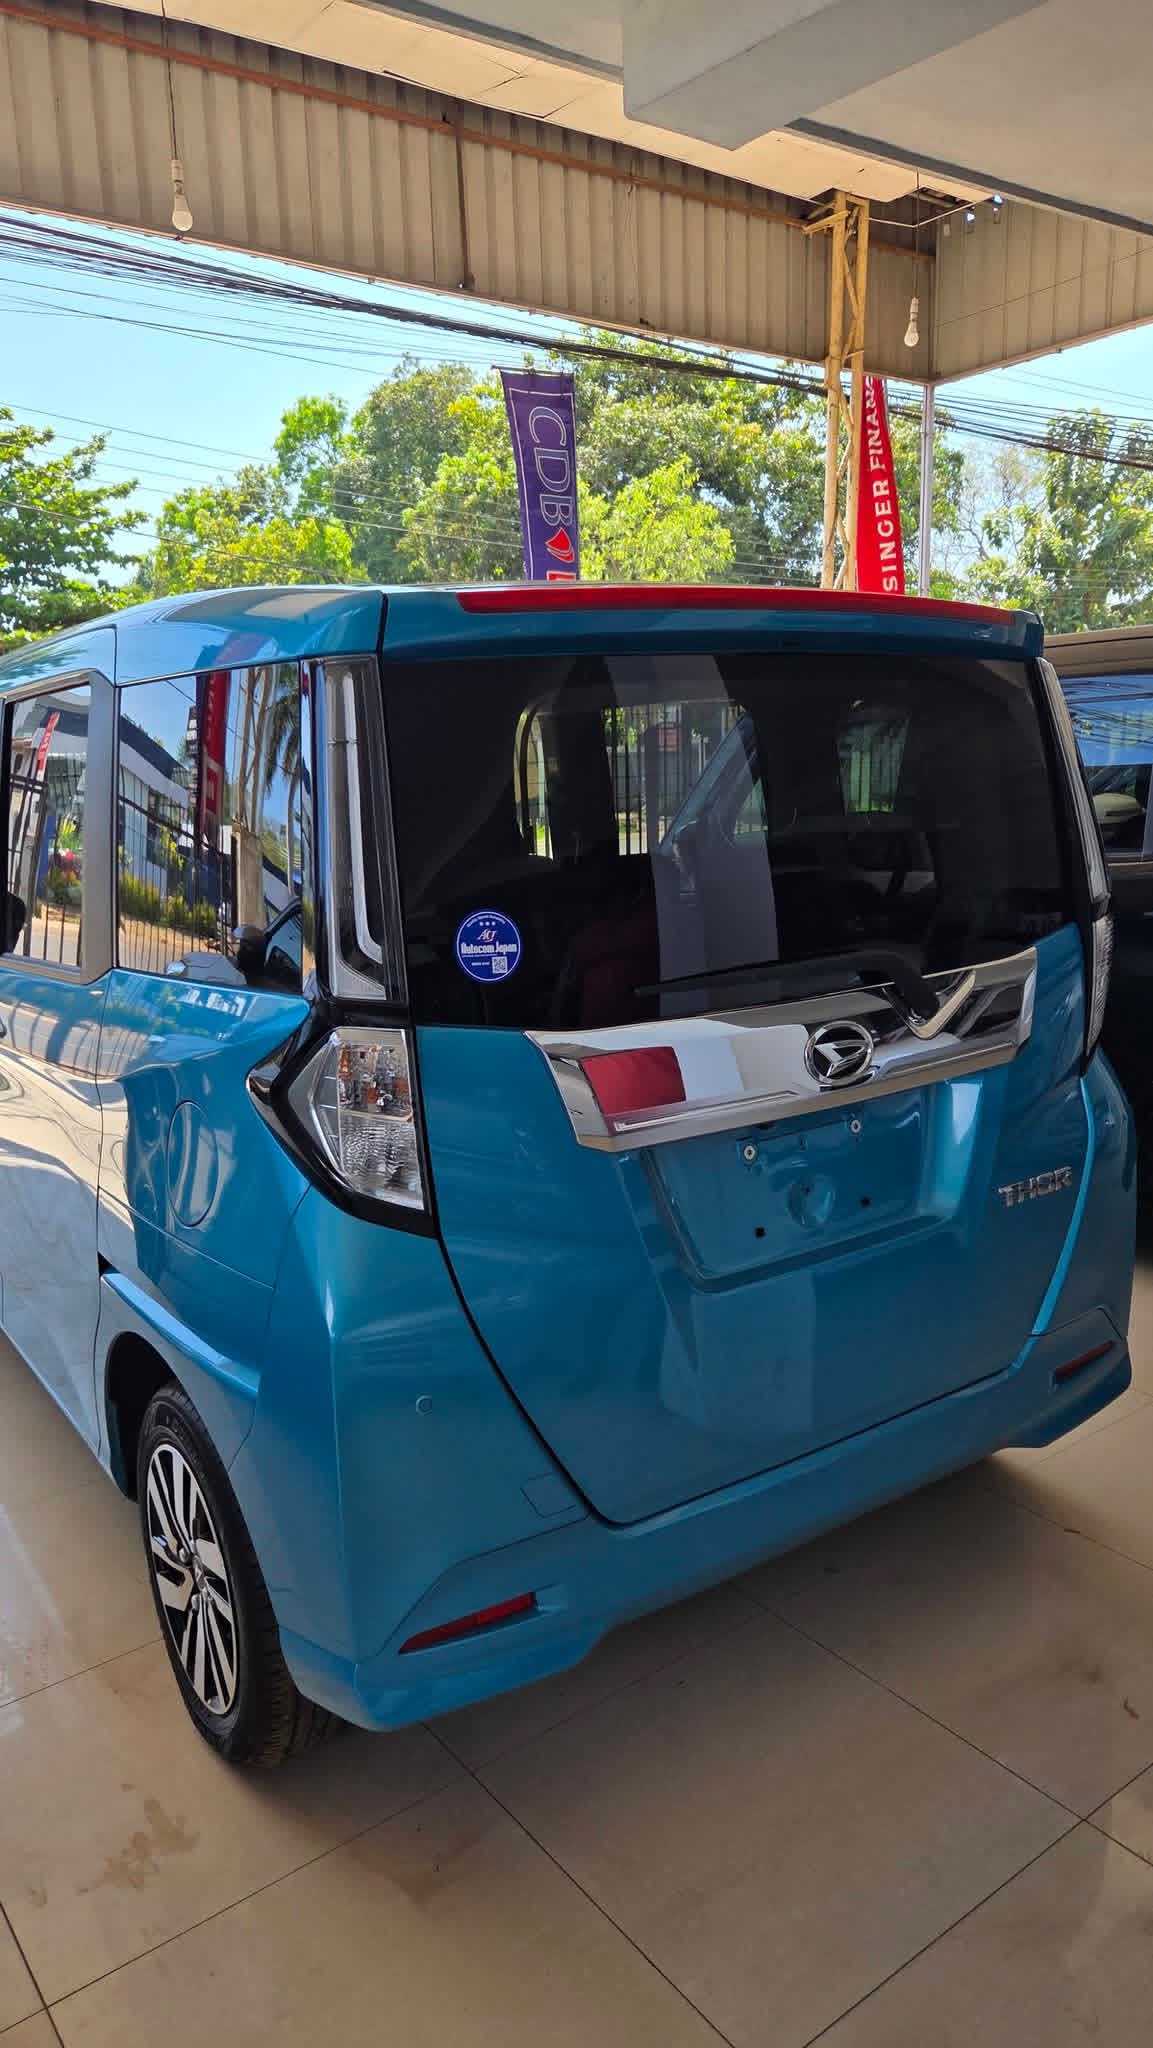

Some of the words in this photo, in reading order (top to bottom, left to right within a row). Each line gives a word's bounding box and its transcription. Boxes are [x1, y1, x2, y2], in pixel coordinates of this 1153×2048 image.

[528, 406, 573, 528] CDB
[872, 479, 899, 592] SINGER
[495, 941, 517, 955] Japan
[998, 1166, 1072, 1208] THOR
